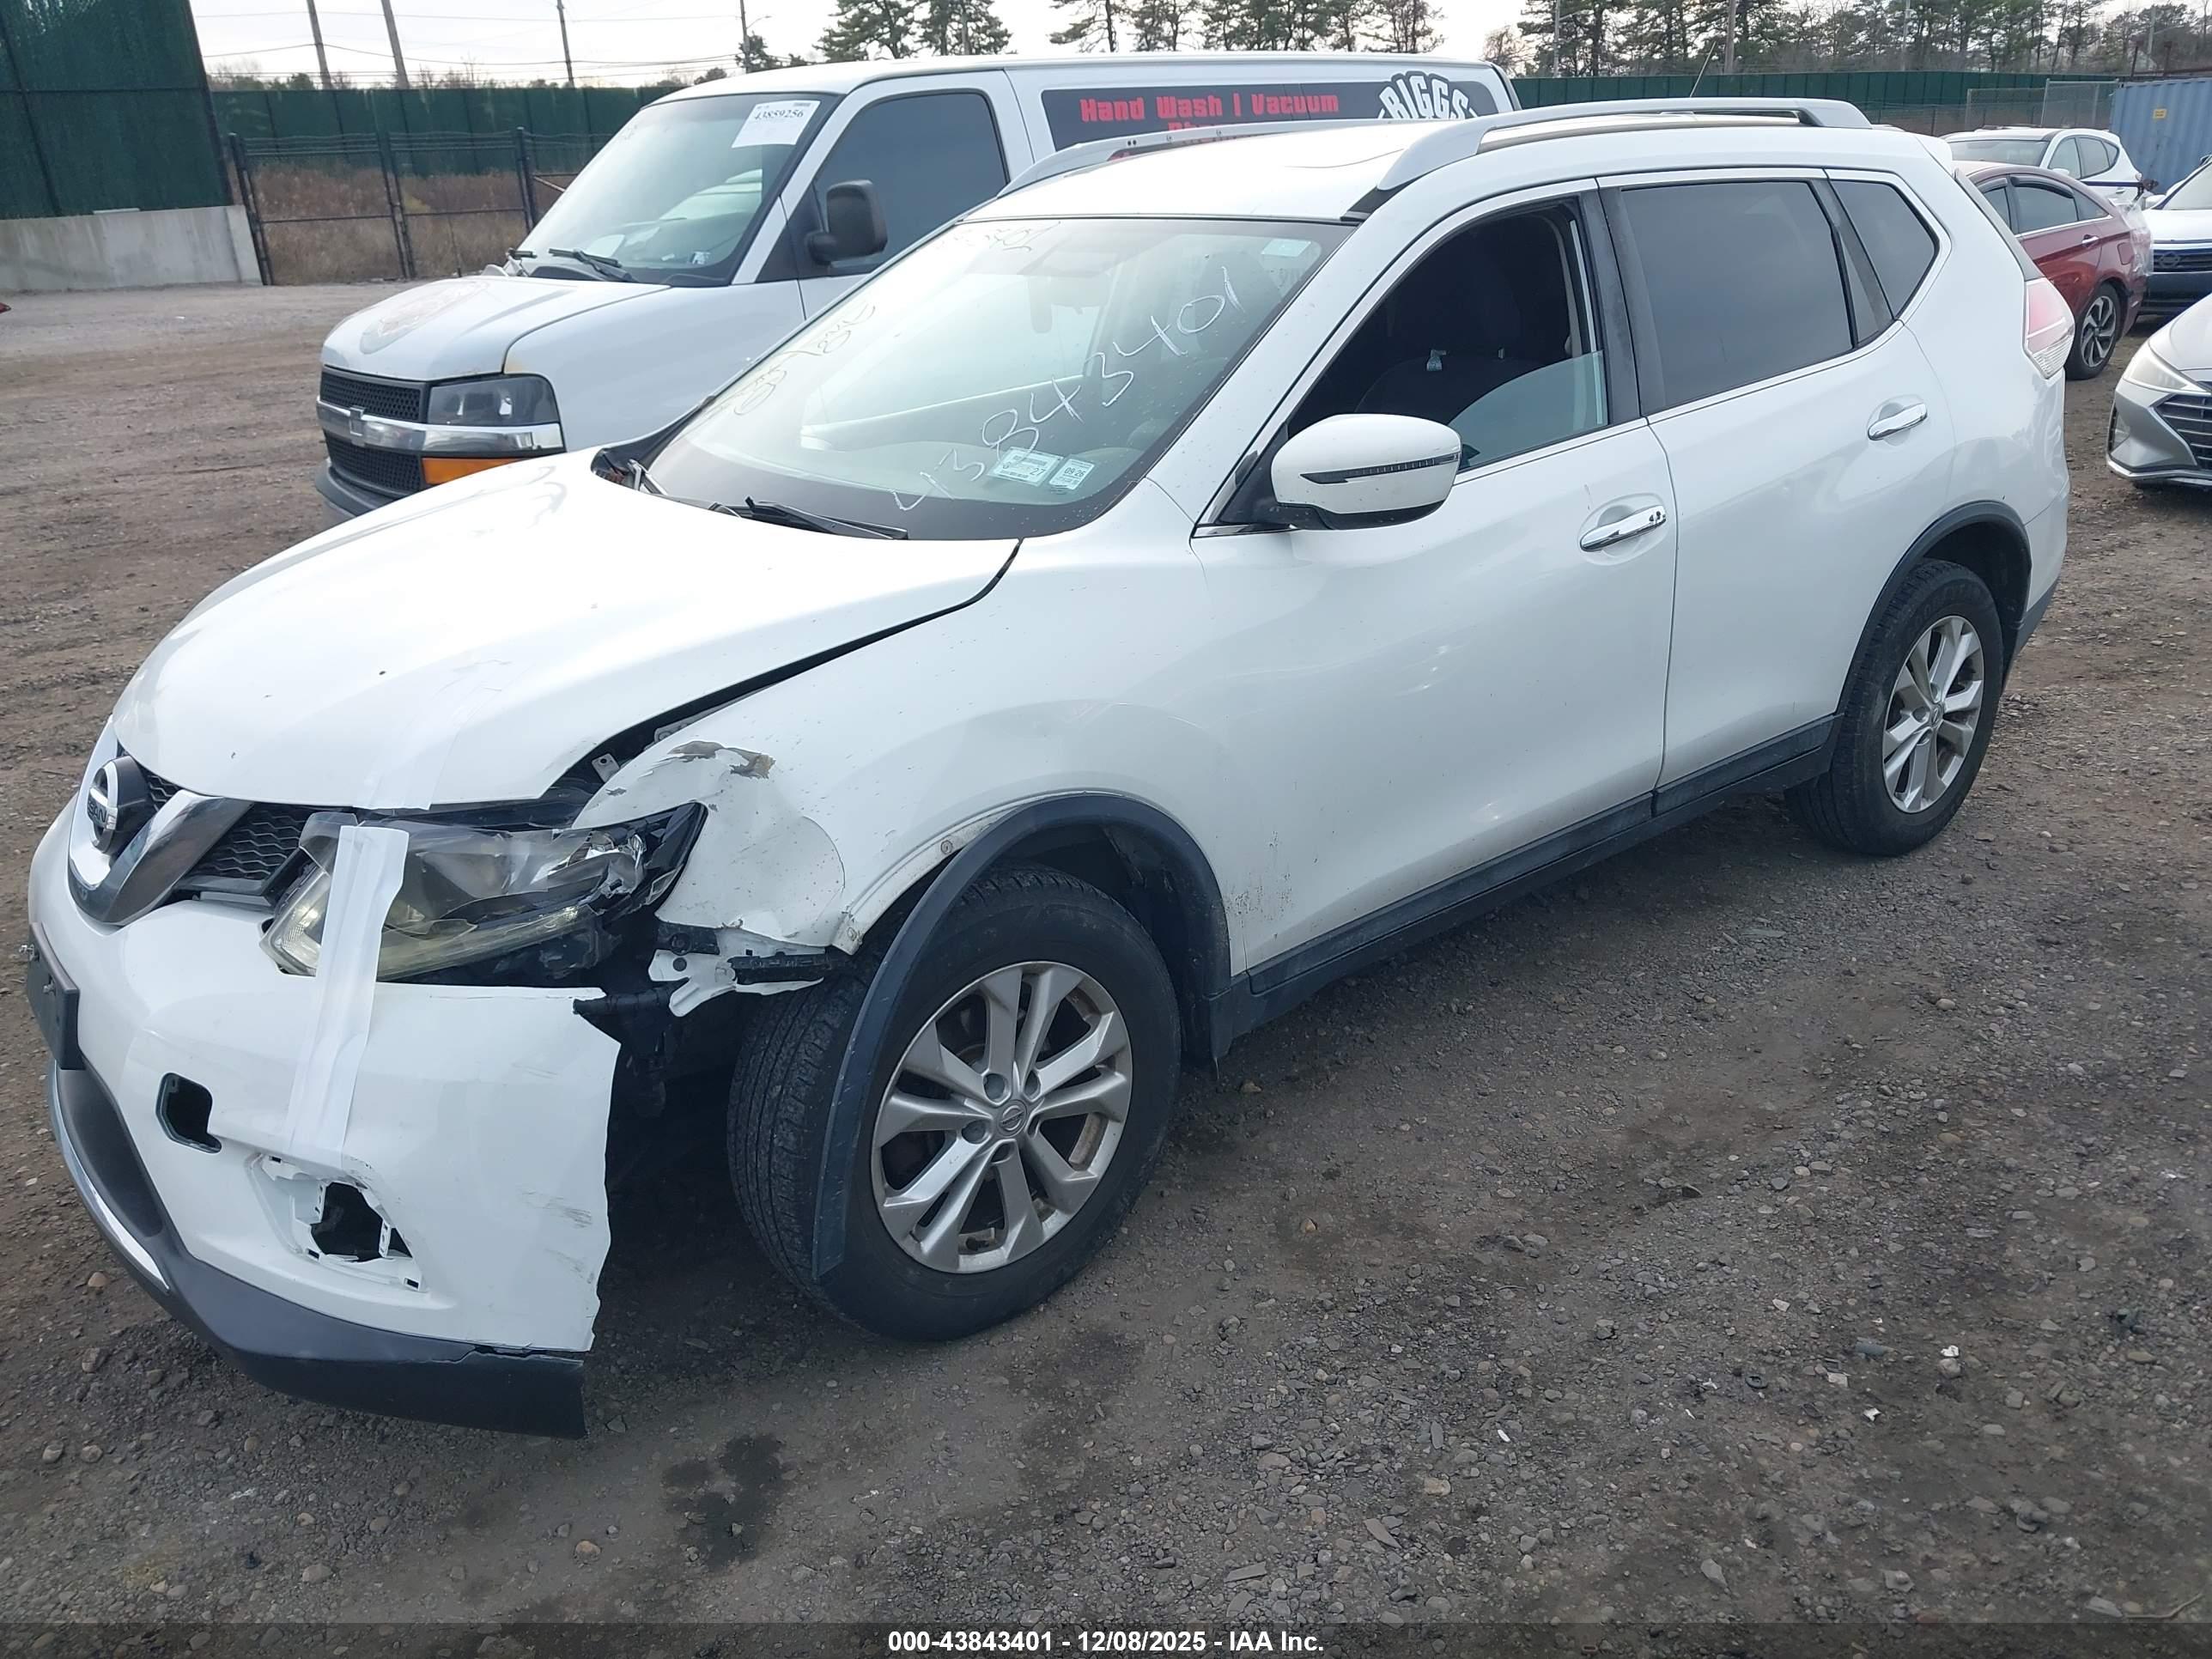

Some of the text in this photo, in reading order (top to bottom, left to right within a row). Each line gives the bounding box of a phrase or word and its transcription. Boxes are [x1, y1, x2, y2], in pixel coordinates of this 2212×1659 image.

[1079, 96, 1145, 122] Hand
[1157, 93, 1223, 118] Wash
[1251, 93, 1340, 115] Vacuum
